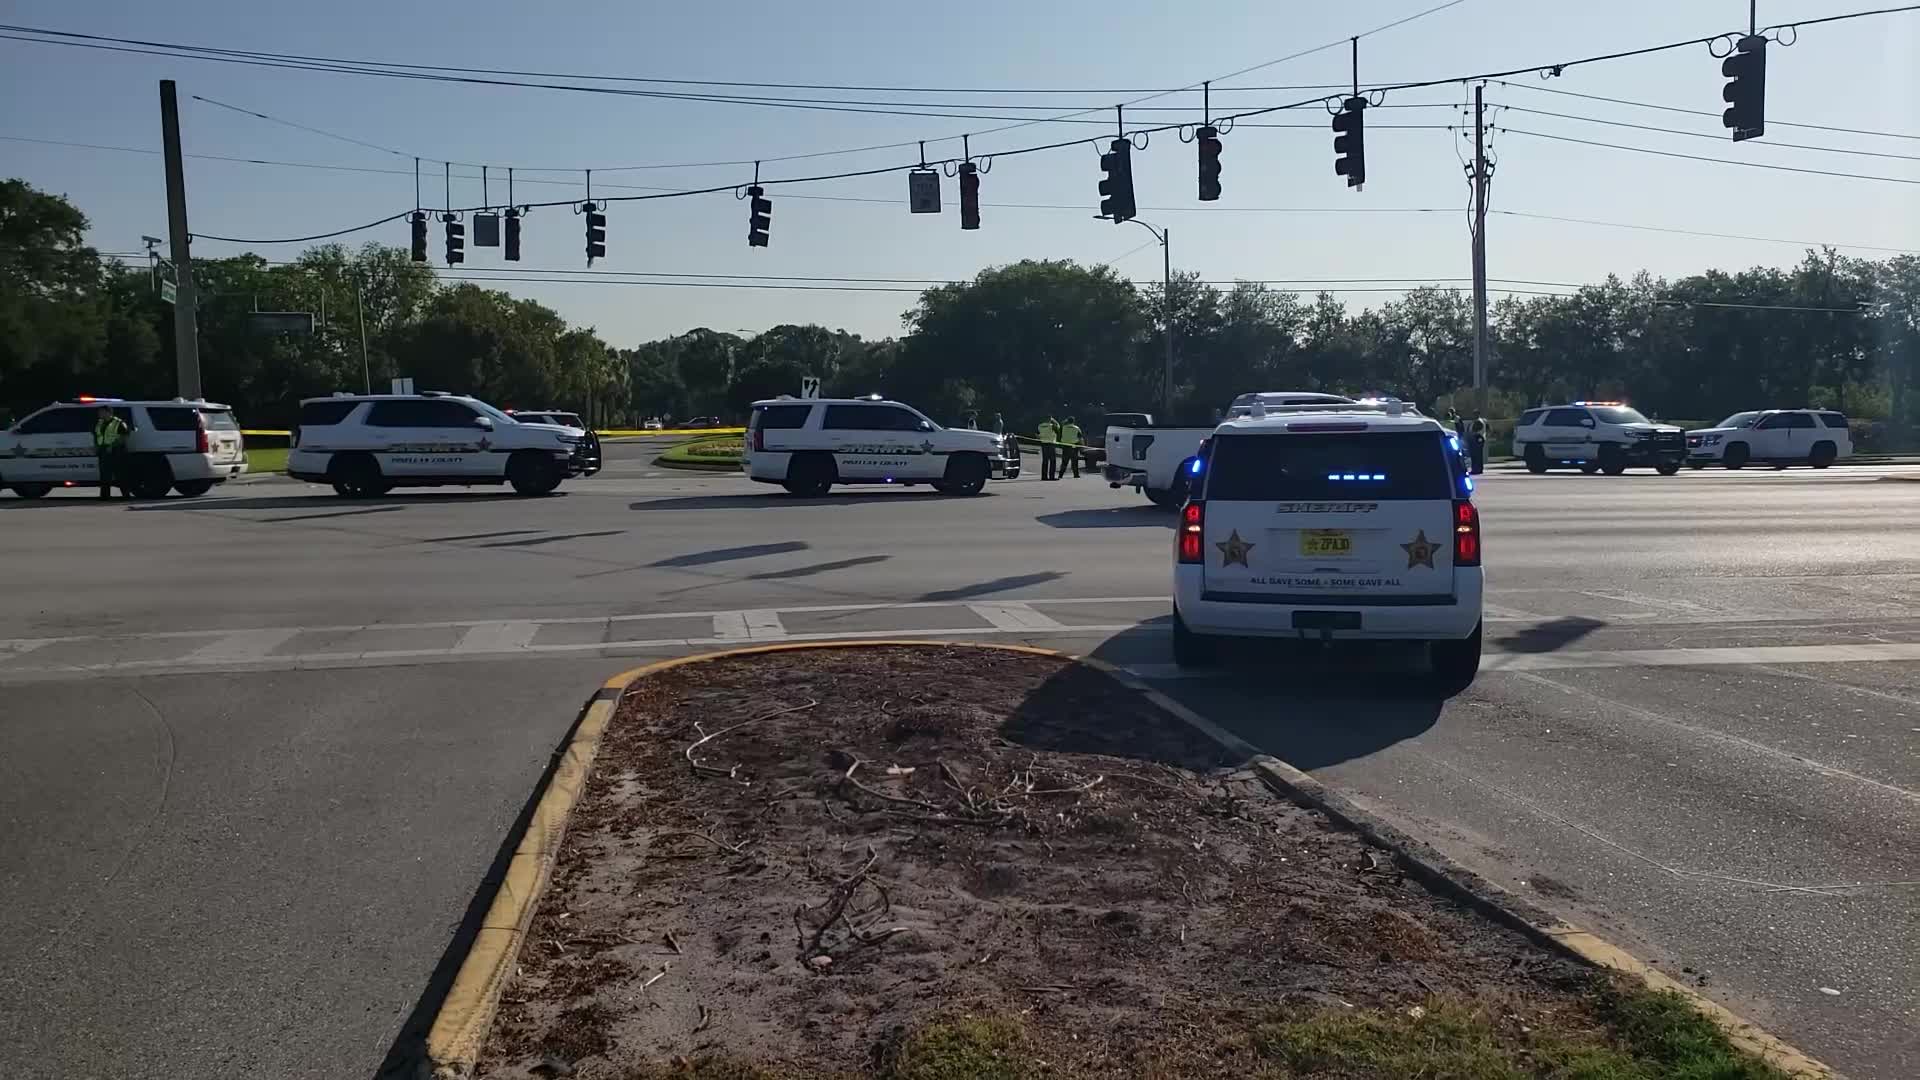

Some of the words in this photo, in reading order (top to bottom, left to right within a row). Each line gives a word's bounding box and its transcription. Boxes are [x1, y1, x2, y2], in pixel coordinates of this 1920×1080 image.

[1276, 503, 1379, 513] SHERIFF
[1249, 577, 1266, 585] ALL
[1268, 577, 1293, 585] GAVE
[1295, 577, 1320, 586] SOME
[1330, 578, 1356, 586] SOME
[1358, 578, 1382, 586] GAVE
[1384, 577, 1400, 586] ALL
